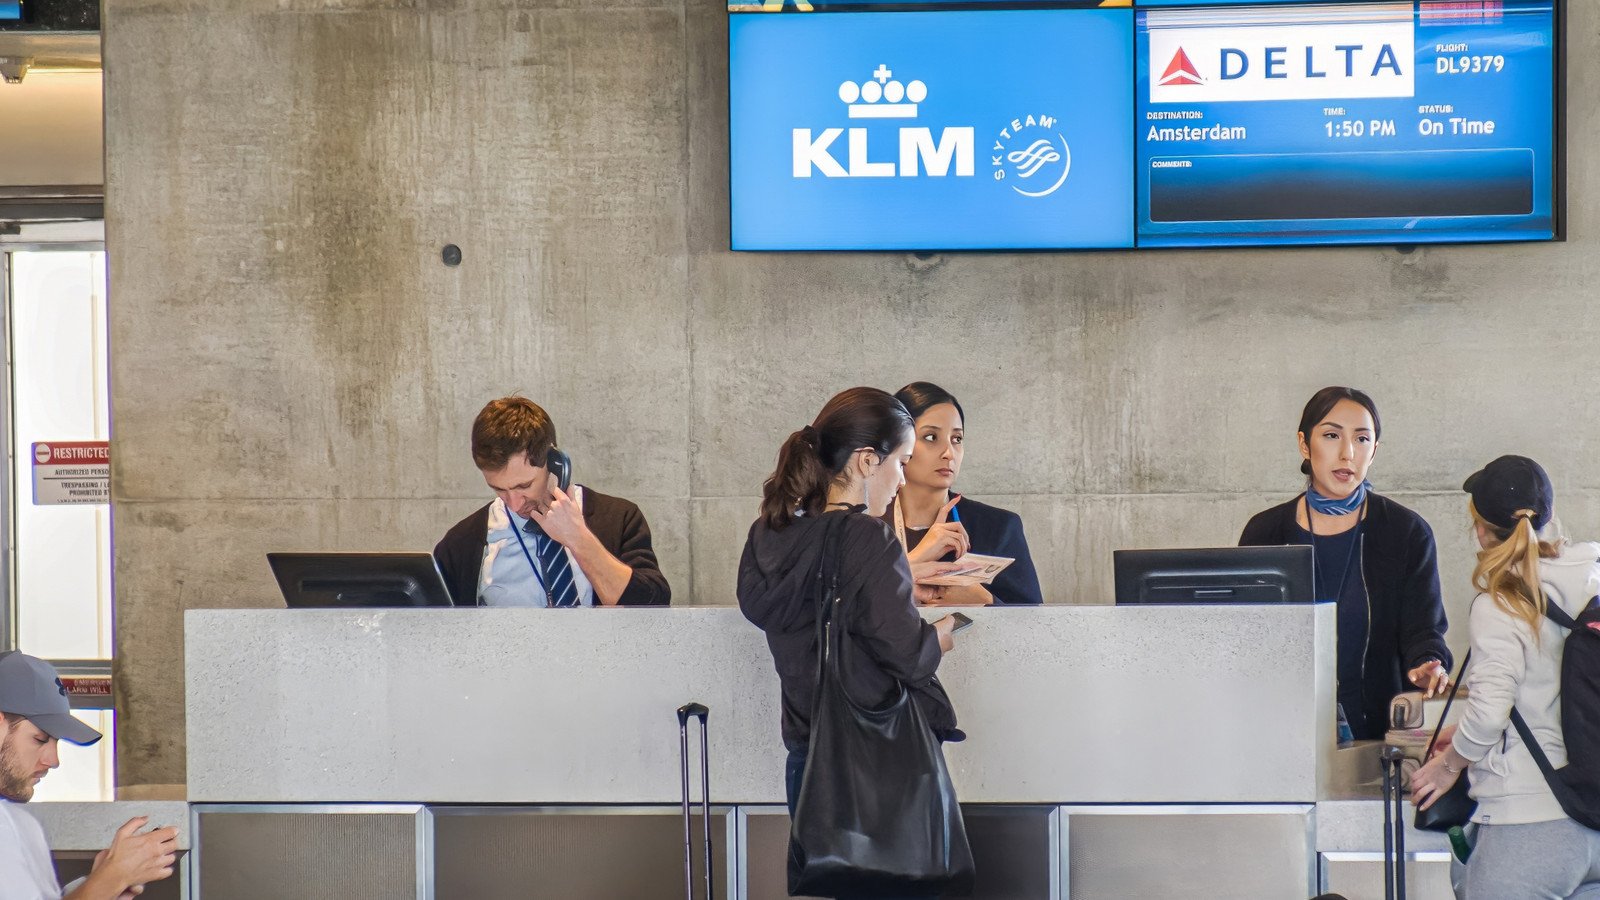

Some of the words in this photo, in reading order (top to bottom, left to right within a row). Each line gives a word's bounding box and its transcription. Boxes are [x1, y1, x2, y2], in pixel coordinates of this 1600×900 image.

[1436, 43, 1468, 53] FLIGHT:
[1220, 43, 1403, 81] DELTA
[1436, 55, 1505, 74] DL9379
[1146, 111, 1203, 120] DESTINATION:
[1323, 107, 1346, 116] TIME:
[1418, 104, 1454, 114] STATUS:
[1147, 123, 1246, 142] Amsterdam
[1325, 119, 1365, 138] 1:50
[1369, 119, 1396, 137] PM
[1418, 118, 1444, 136] On
[1449, 117, 1496, 135] Time
[792, 126, 975, 178] KLM
[1152, 160, 1192, 168] COMMENTS:
[55, 468, 89, 476] AUTHORIZED
